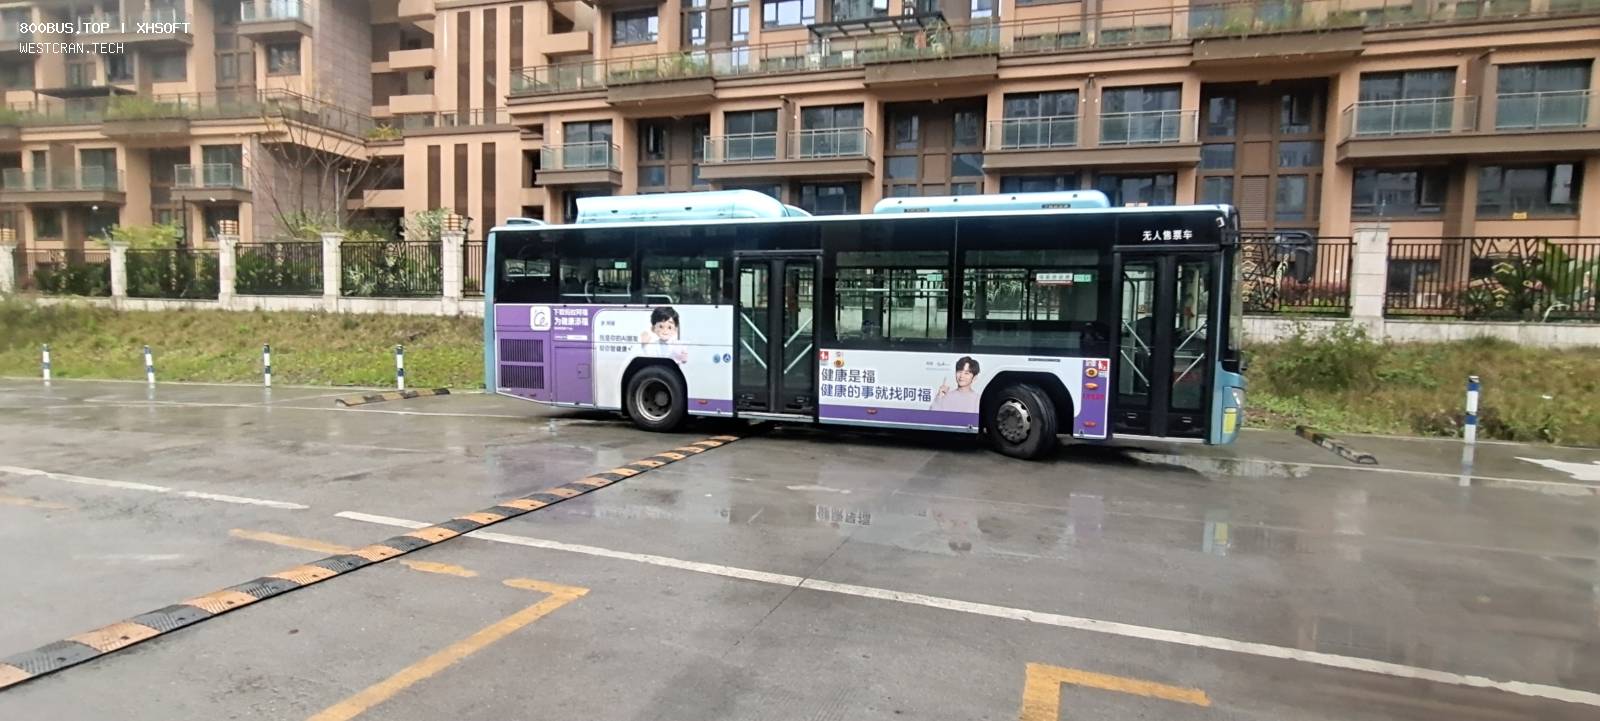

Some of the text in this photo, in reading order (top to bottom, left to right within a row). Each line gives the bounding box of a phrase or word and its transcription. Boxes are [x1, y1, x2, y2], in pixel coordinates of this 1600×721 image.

[1142, 229, 1193, 241] 无人售票车
[821, 367, 876, 384] 健康是福
[820, 383, 932, 403] 健康的事就找阿福
